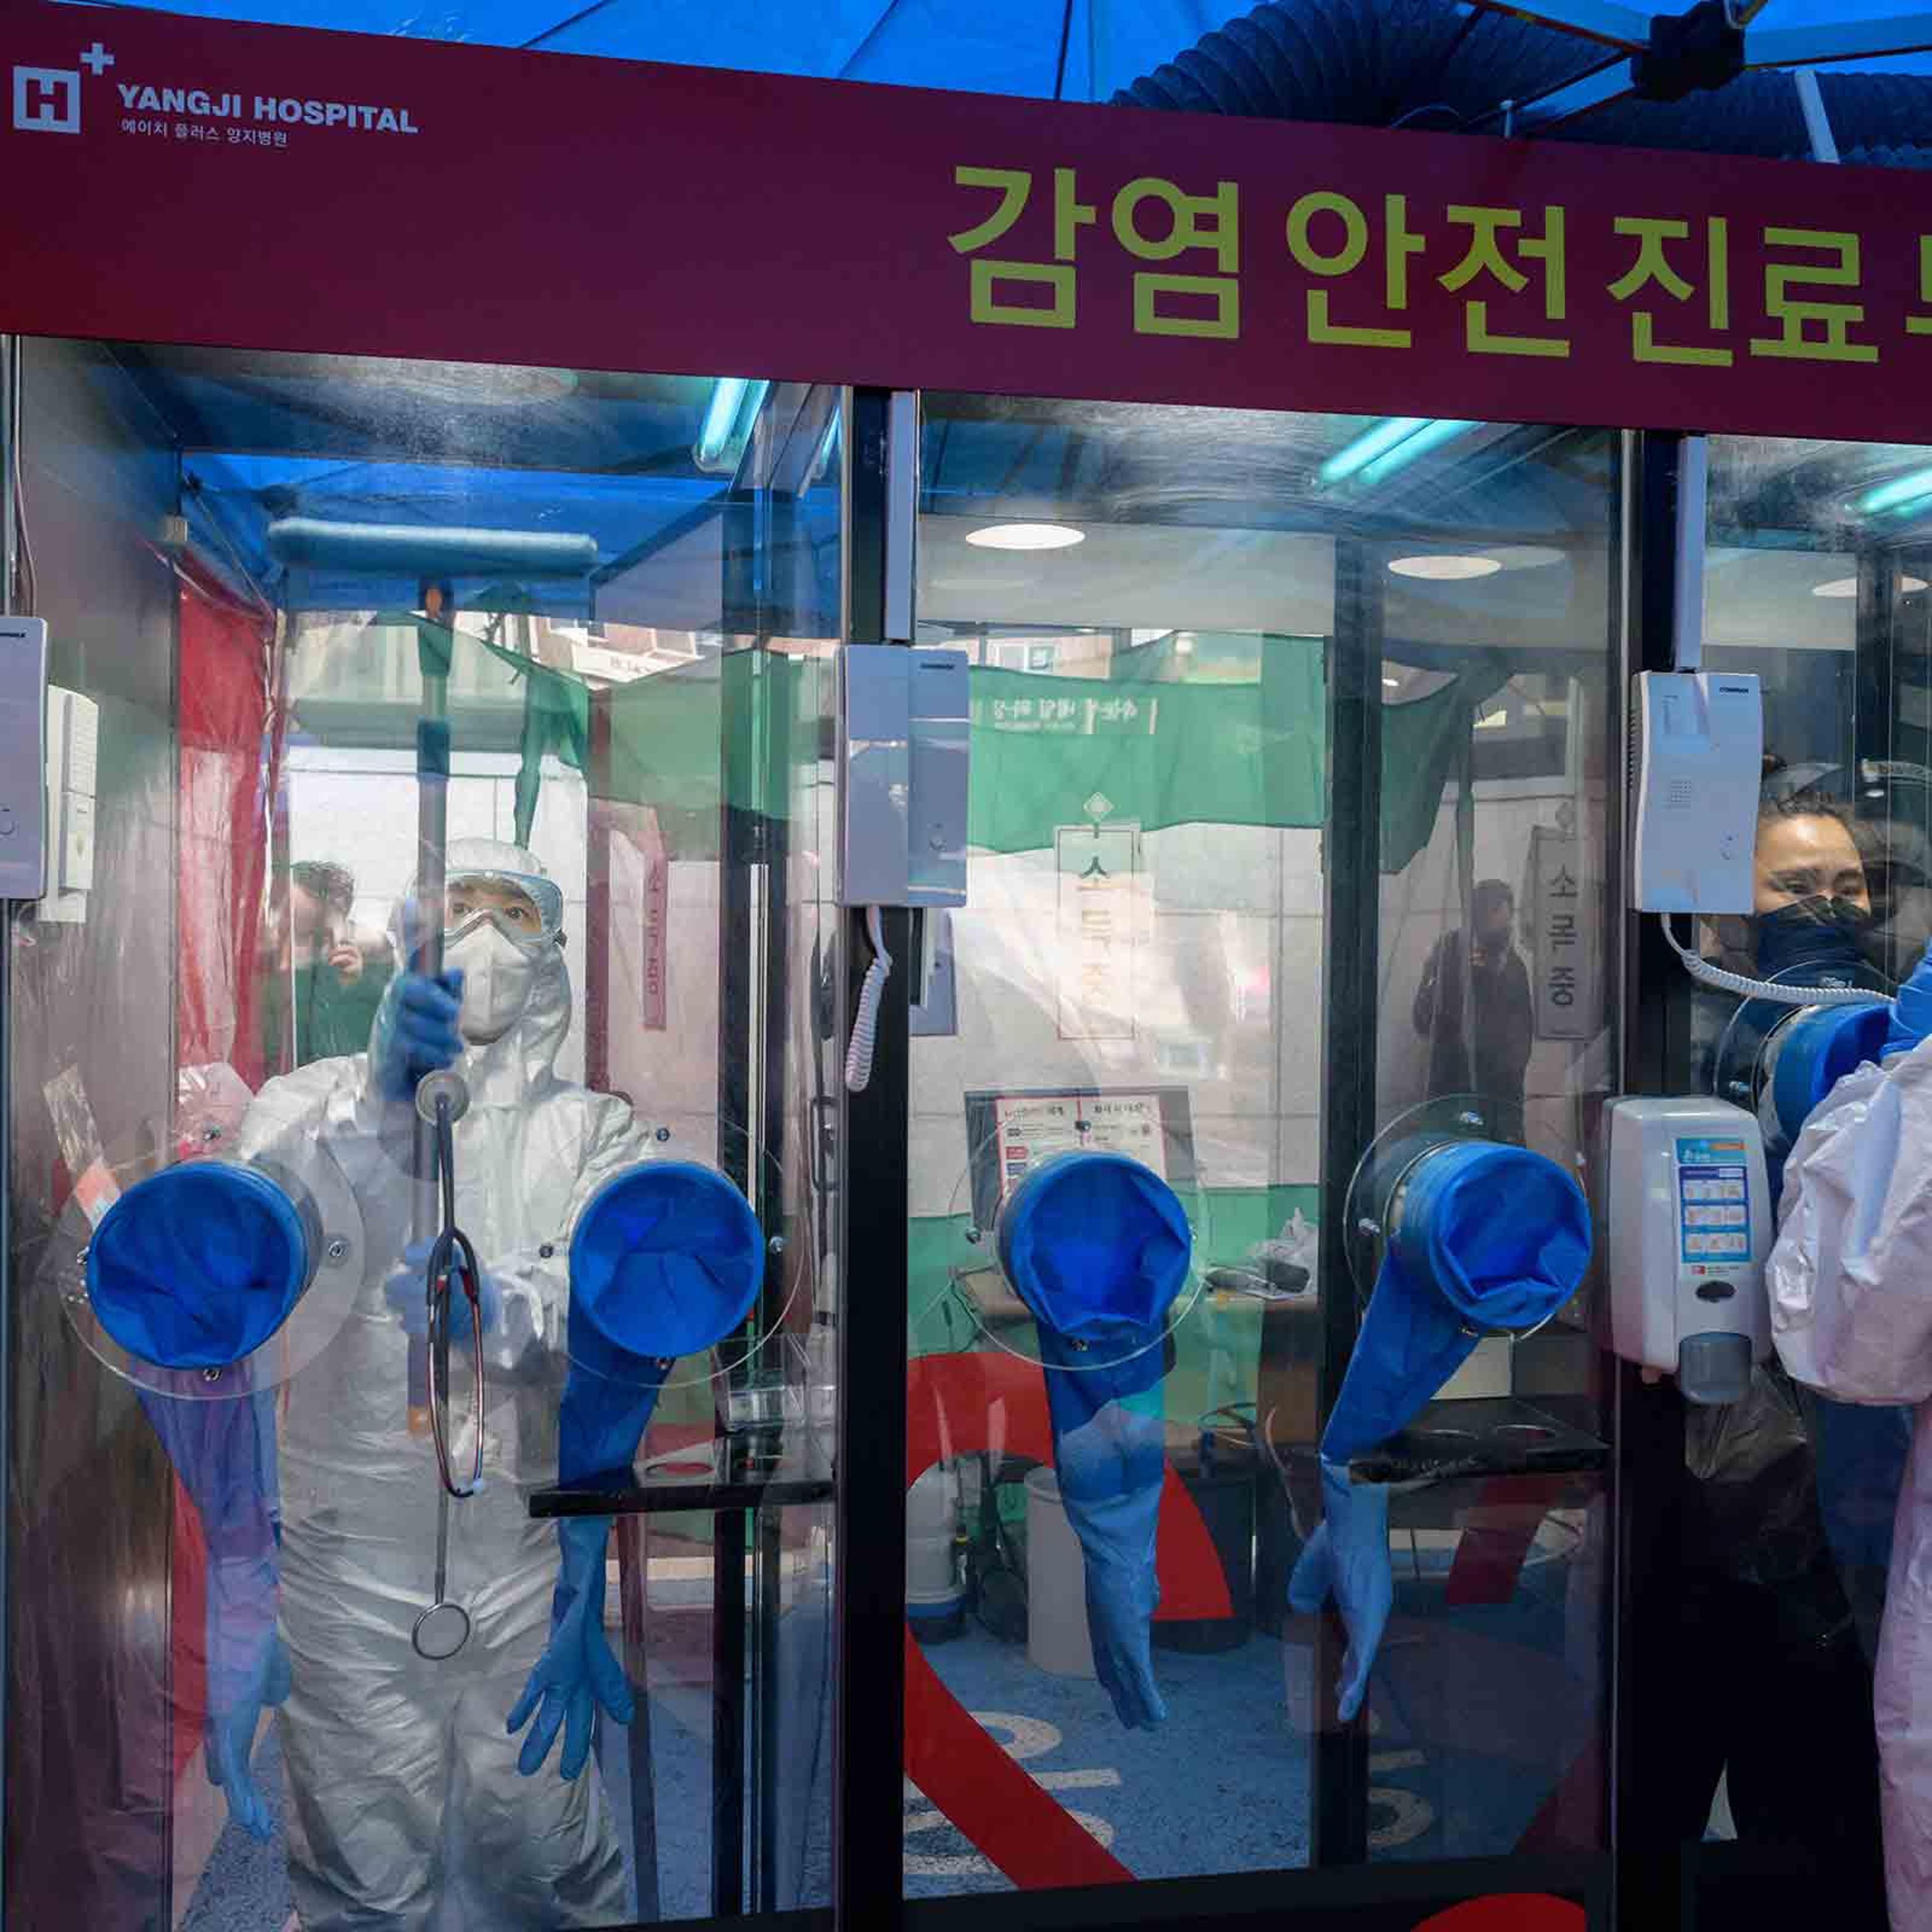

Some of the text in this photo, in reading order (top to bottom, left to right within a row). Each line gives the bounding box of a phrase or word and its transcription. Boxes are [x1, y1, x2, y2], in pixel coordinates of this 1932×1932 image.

[117, 84, 418, 134] YANGJI HOSPITAL
[122, 119, 168, 138] 에이치
[227, 127, 290, 148] 양지병원
[947, 166, 1239, 340] 감염
[1285, 191, 1570, 358] 안전
[1606, 215, 1880, 367] 진료
